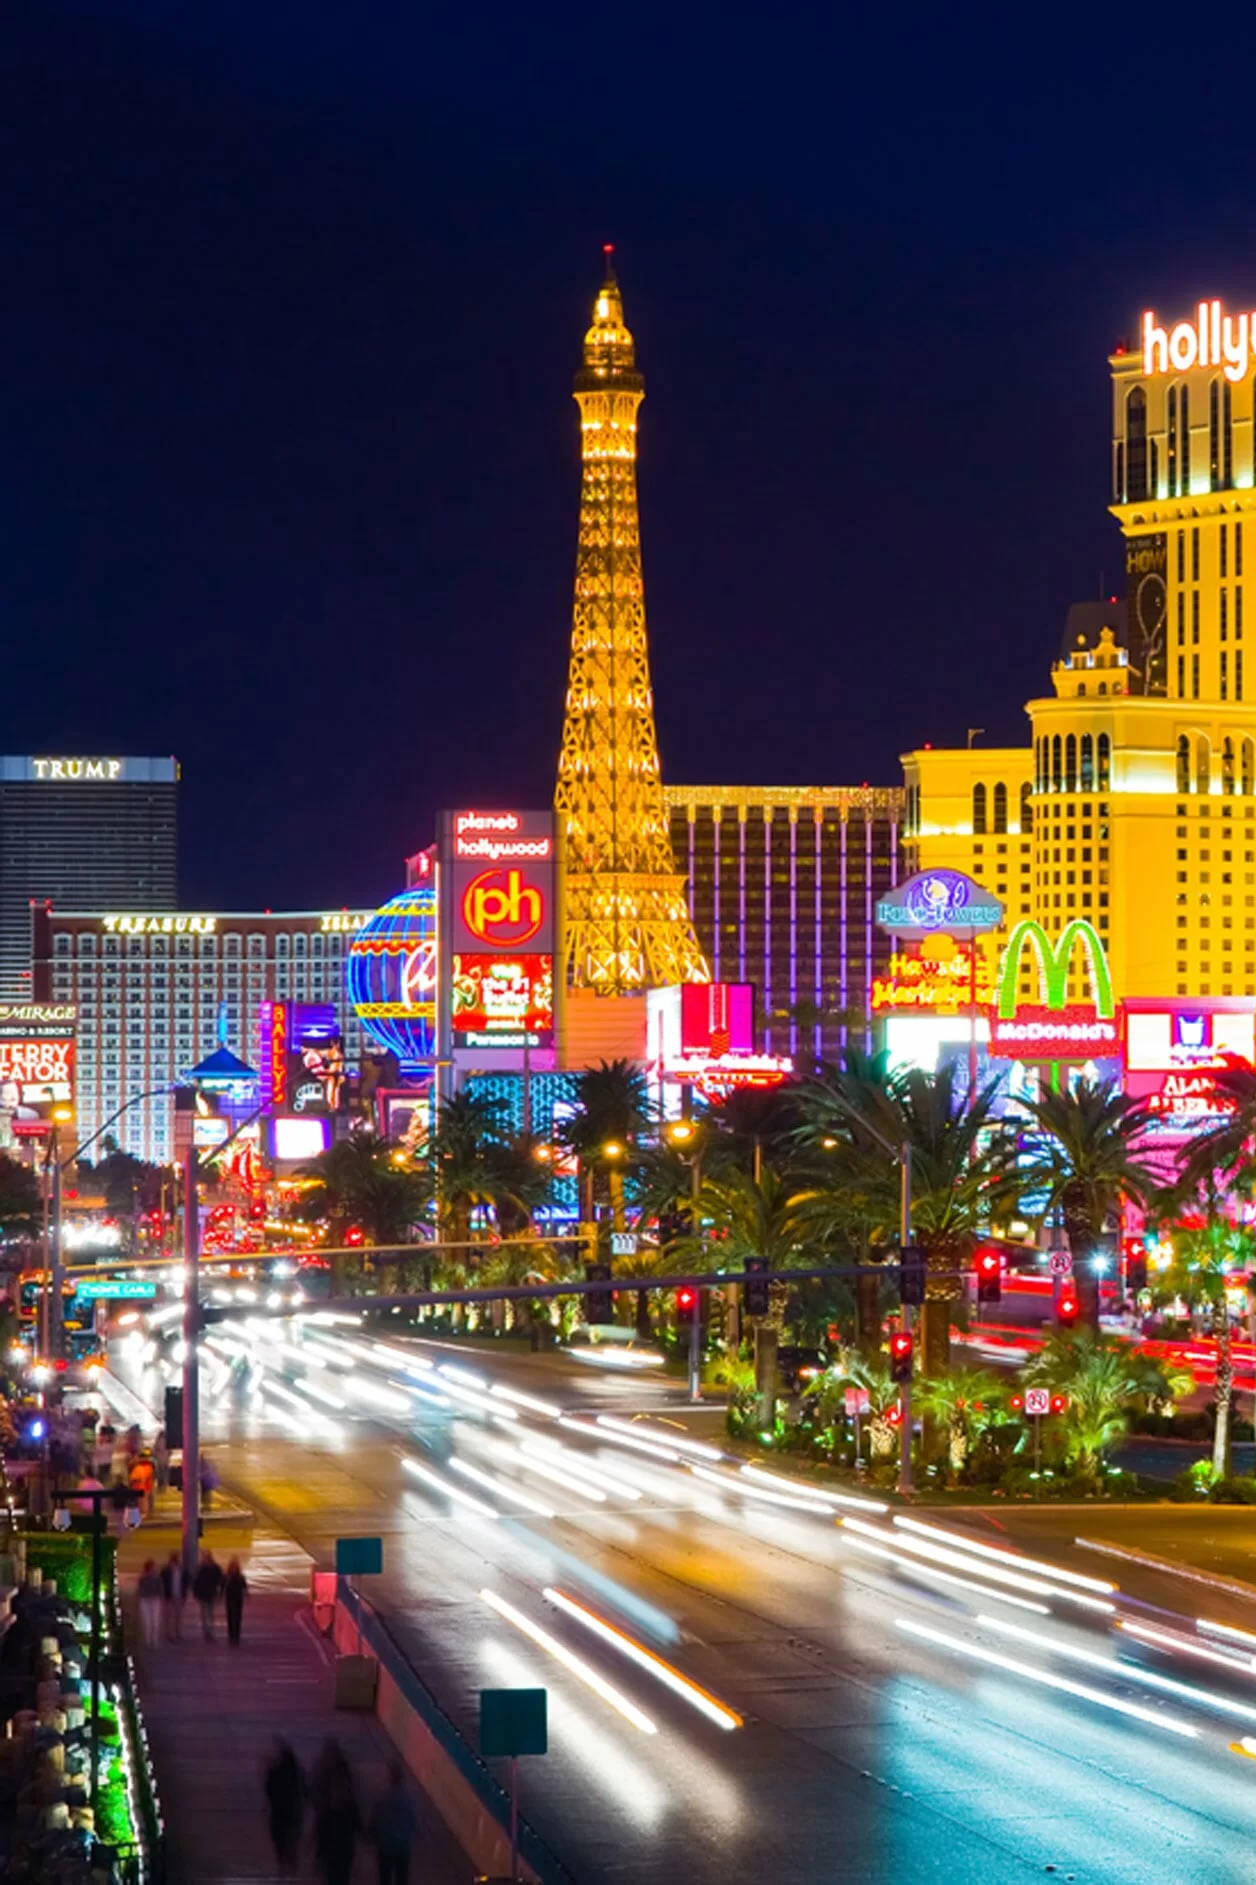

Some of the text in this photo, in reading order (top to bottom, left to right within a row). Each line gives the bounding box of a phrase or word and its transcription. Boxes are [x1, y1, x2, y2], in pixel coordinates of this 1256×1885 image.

[33, 759, 121, 779] TRUMP
[457, 811, 518, 835] planet
[457, 837, 549, 860] hollywood
[474, 870, 542, 934] ph
[102, 915, 217, 934] TREASURE
[10, 1005, 77, 1021] MIRAGE
[996, 1022, 1117, 1041] McDonald's
[0, 1042, 70, 1065] TERRY
[0, 1063, 69, 1082] FATOR
